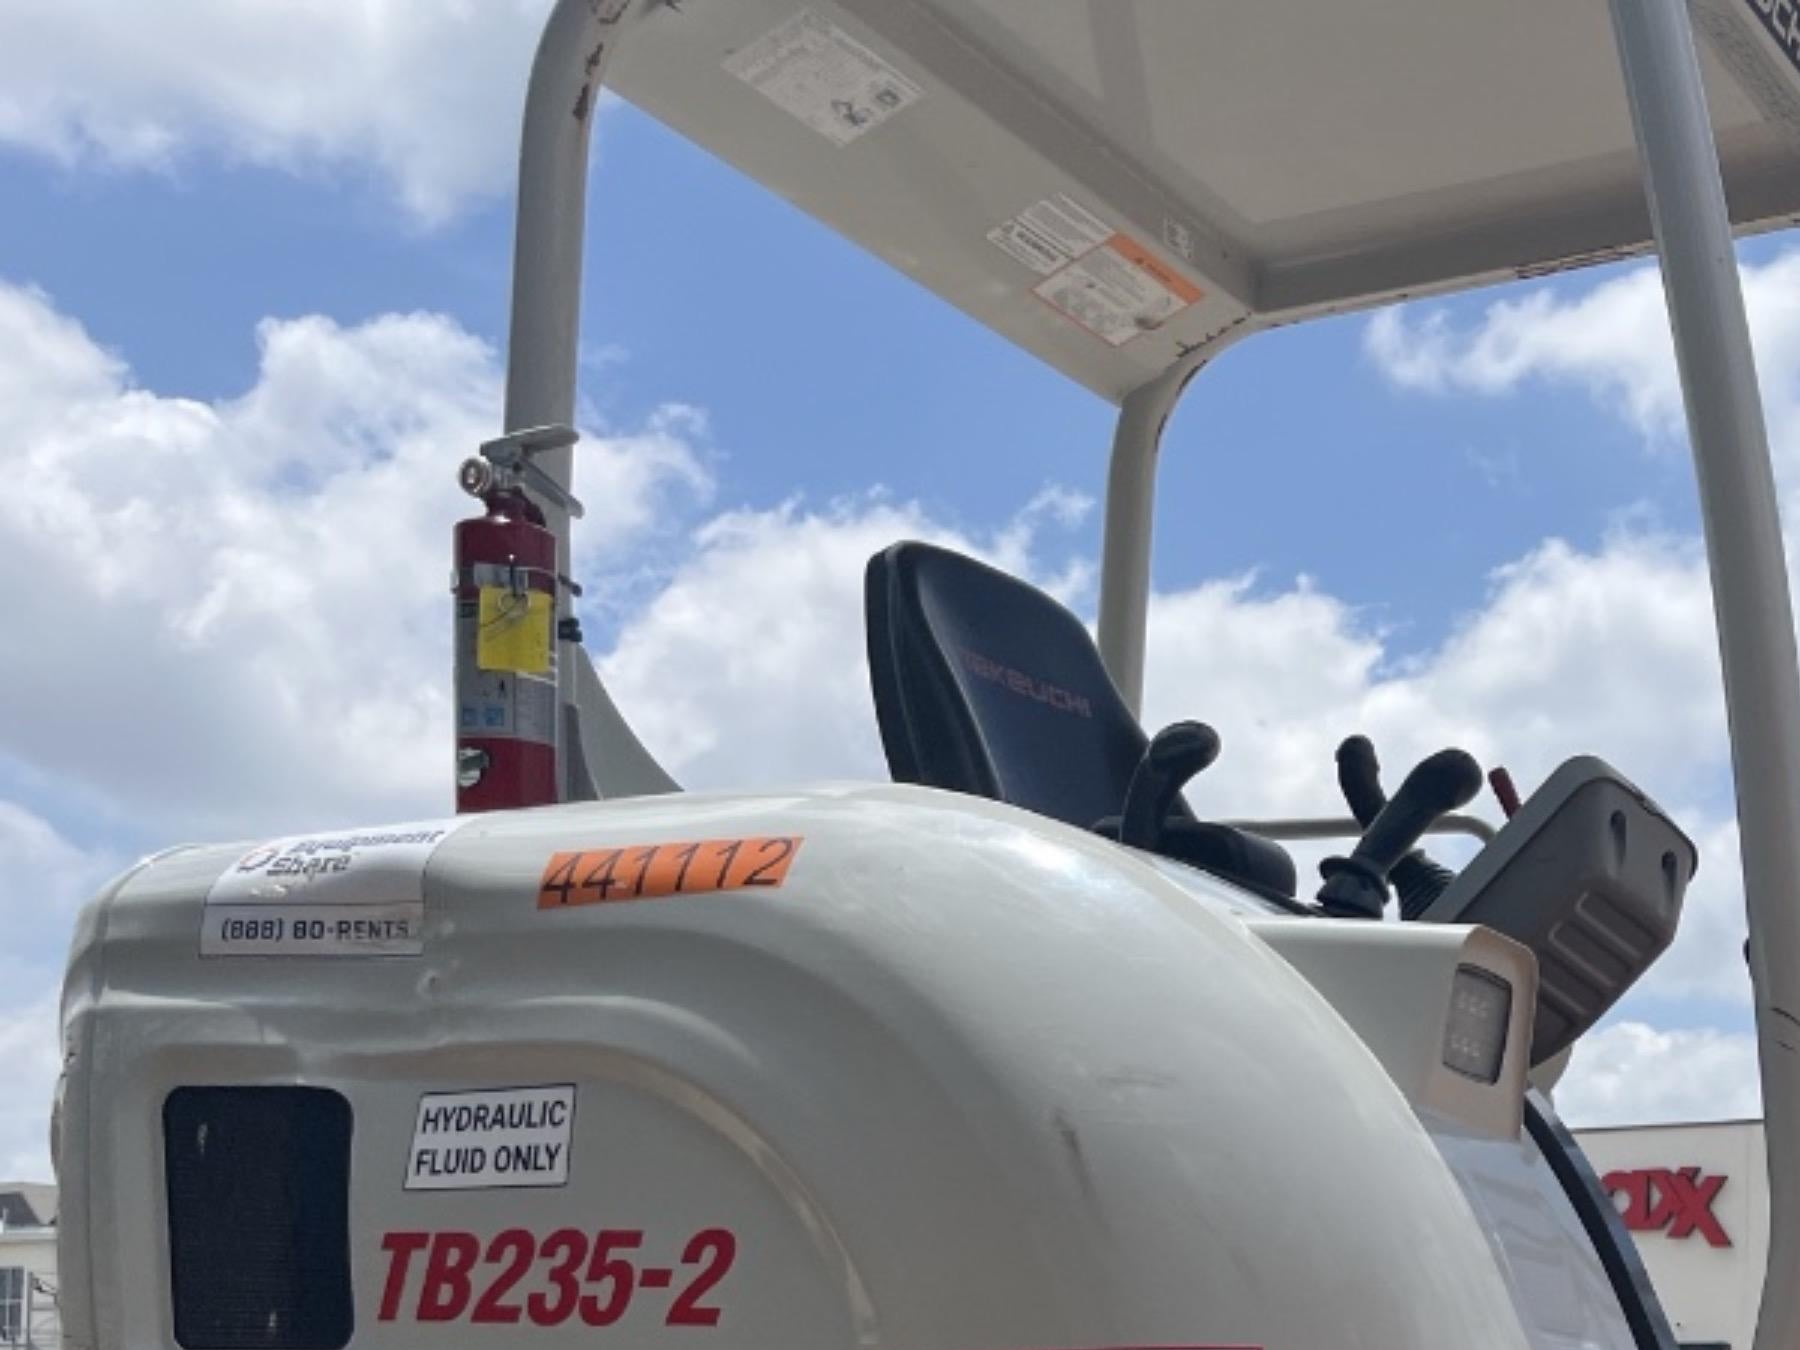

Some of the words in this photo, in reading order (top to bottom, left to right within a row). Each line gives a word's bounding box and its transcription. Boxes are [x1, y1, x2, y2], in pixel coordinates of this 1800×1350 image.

[543, 837, 793, 904] 441112
[221, 917, 284, 943] (888)
[421, 1099, 566, 1135] HYDRAULIC
[415, 1148, 486, 1177] FLUID
[493, 1142, 562, 1172] ONLY
[377, 1227, 737, 1328] TB235-2
